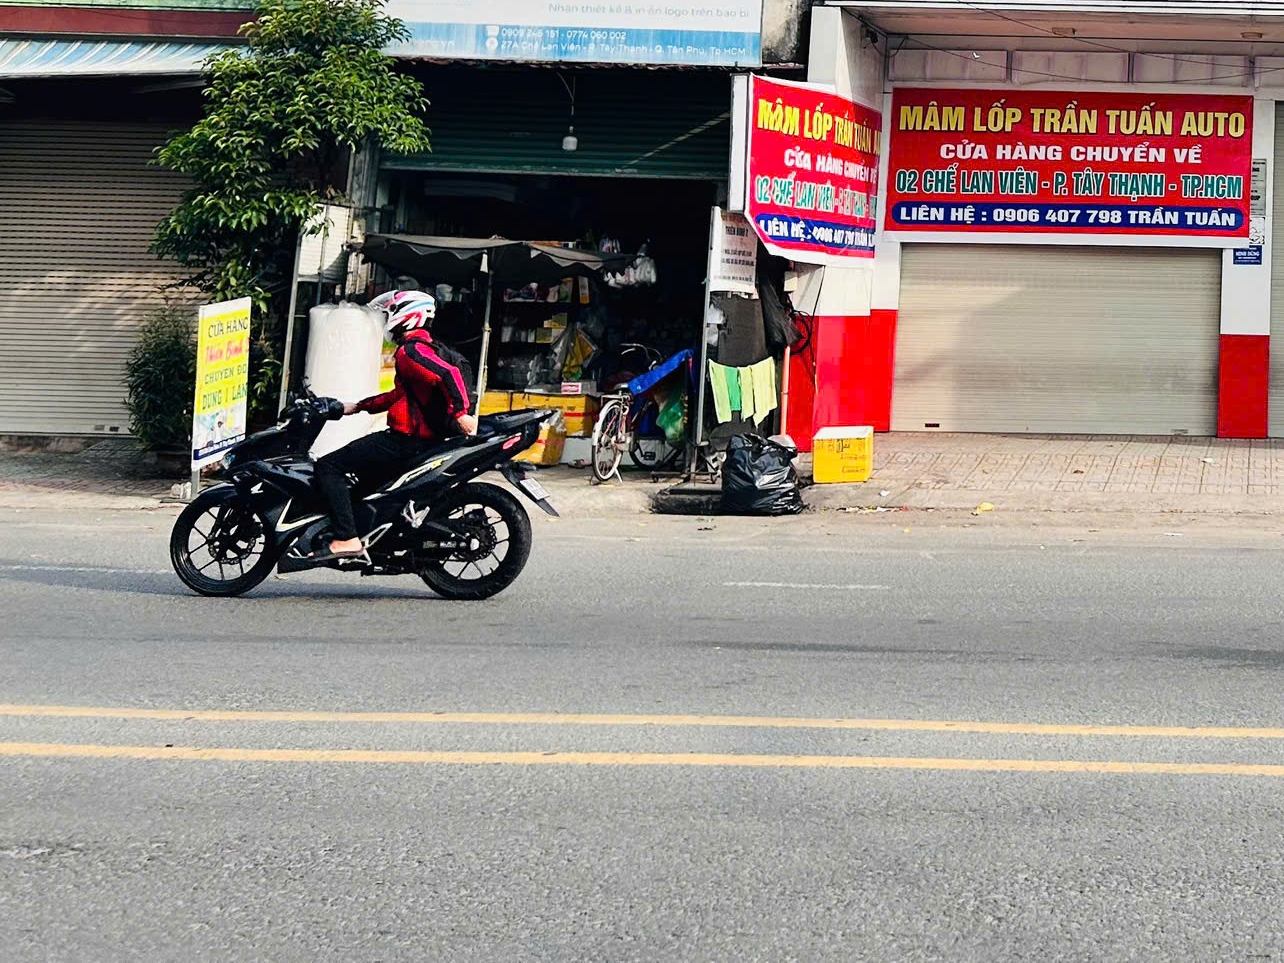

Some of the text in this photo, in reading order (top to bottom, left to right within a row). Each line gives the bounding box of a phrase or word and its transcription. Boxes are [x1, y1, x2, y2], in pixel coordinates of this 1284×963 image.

[758, 98, 800, 136] MÂM
[804, 102, 833, 141] LỐP
[899, 99, 1245, 138] MÂM LỐP TRẦN TUẤN AUTO
[784, 146, 812, 170] CỬA
[815, 150, 843, 175] HÀNG
[940, 139, 1202, 164] CỬA HÀNG CHUYỂN VỀ
[794, 180, 817, 210] LAN
[896, 168, 918, 194] 02
[922, 162, 959, 194] CHẾ
[960, 169, 994, 195] LAN
[998, 166, 1039, 196] VIÊN
[1053, 171, 1068, 196] P.
[1072, 167, 1105, 196] TÂY
[1108, 172, 1165, 202] THẠNH
[1181, 174, 1243, 199] TP.HCM
[759, 217, 789, 238] LIÊN
[790, 221, 806, 242] HỆ
[900, 205, 944, 221] LIÊN
[951, 205, 975, 224] HỆ
[993, 209, 1039, 222] 0906
[1045, 209, 1081, 223] 407
[1086, 210, 1122, 224] 798
[1127, 206, 1179, 225] TRẦN
[1184, 208, 1236, 227] TUẤN
